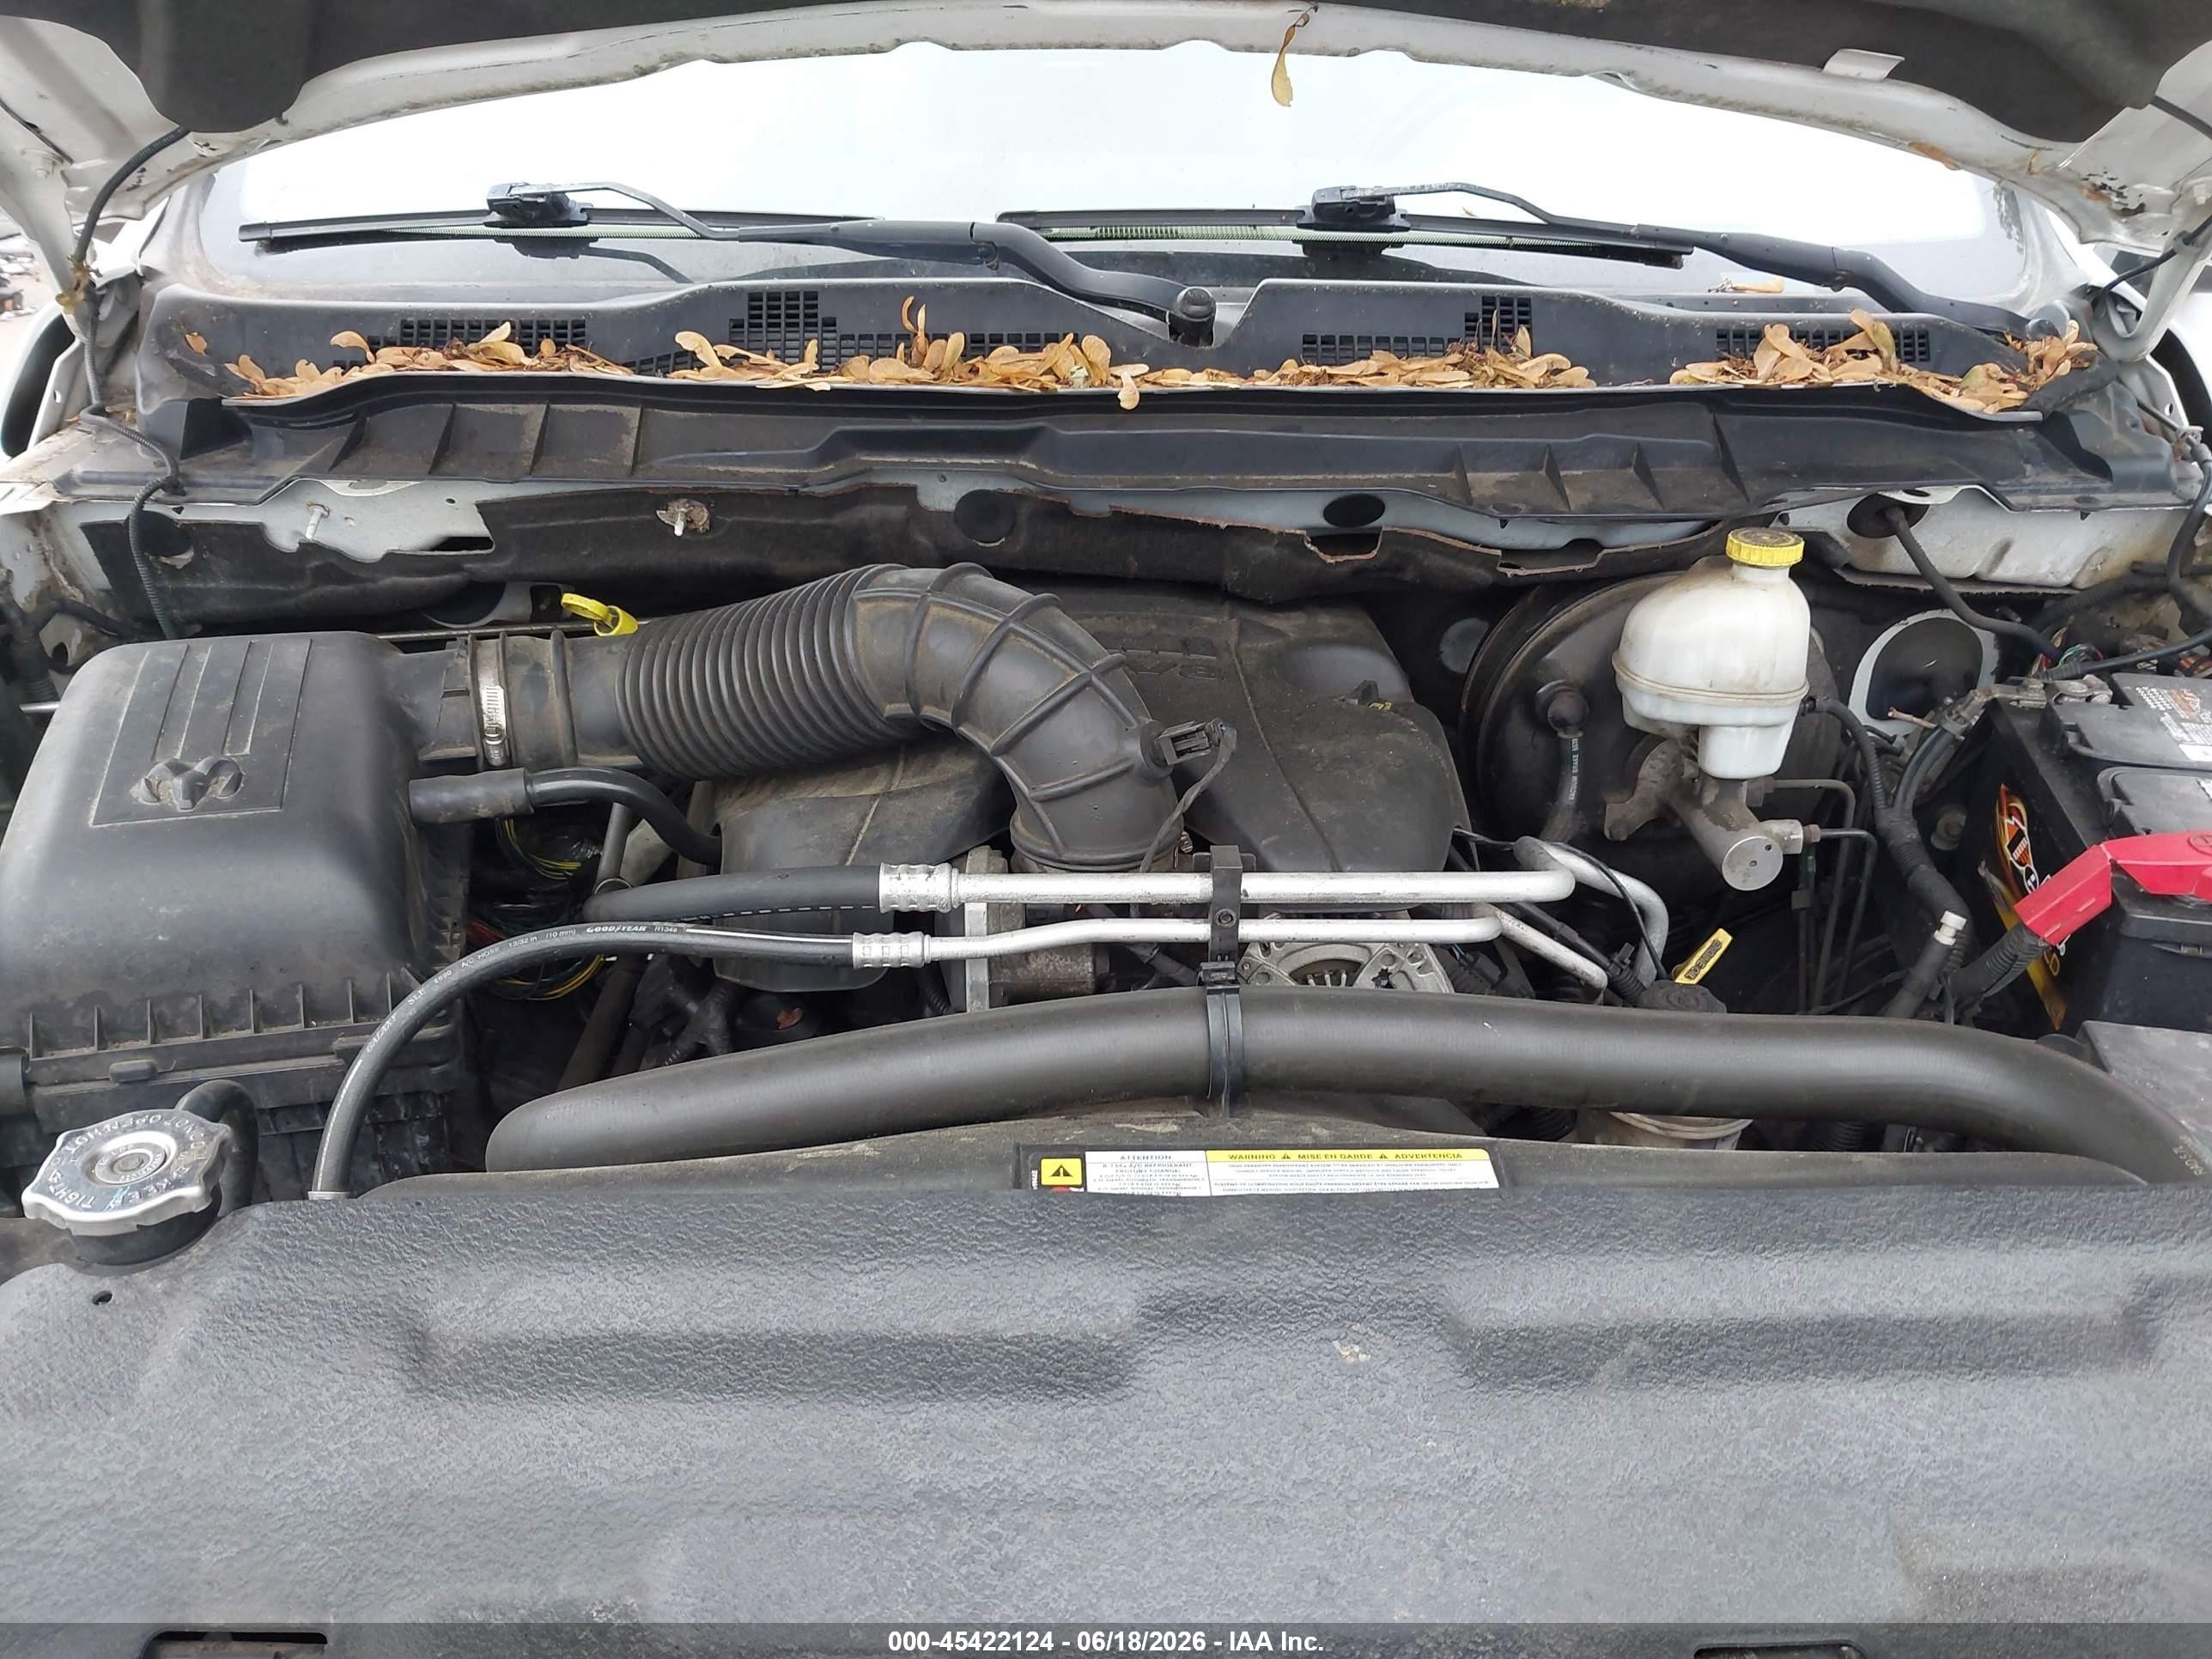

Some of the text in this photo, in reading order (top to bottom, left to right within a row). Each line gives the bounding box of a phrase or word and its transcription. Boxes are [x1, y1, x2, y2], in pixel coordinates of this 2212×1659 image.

[1684, 939, 1723, 981] ENGINE OIL
[367, 1012, 397, 1053] GALAXY
[460, 958, 475, 969] A/C
[477, 947, 500, 960] HOSE
[507, 937, 529, 948] 13/32
[559, 928, 577, 938] mm)
[586, 925, 647, 933] GOODYEAR
[48, 1184, 97, 1209] TIGHT
